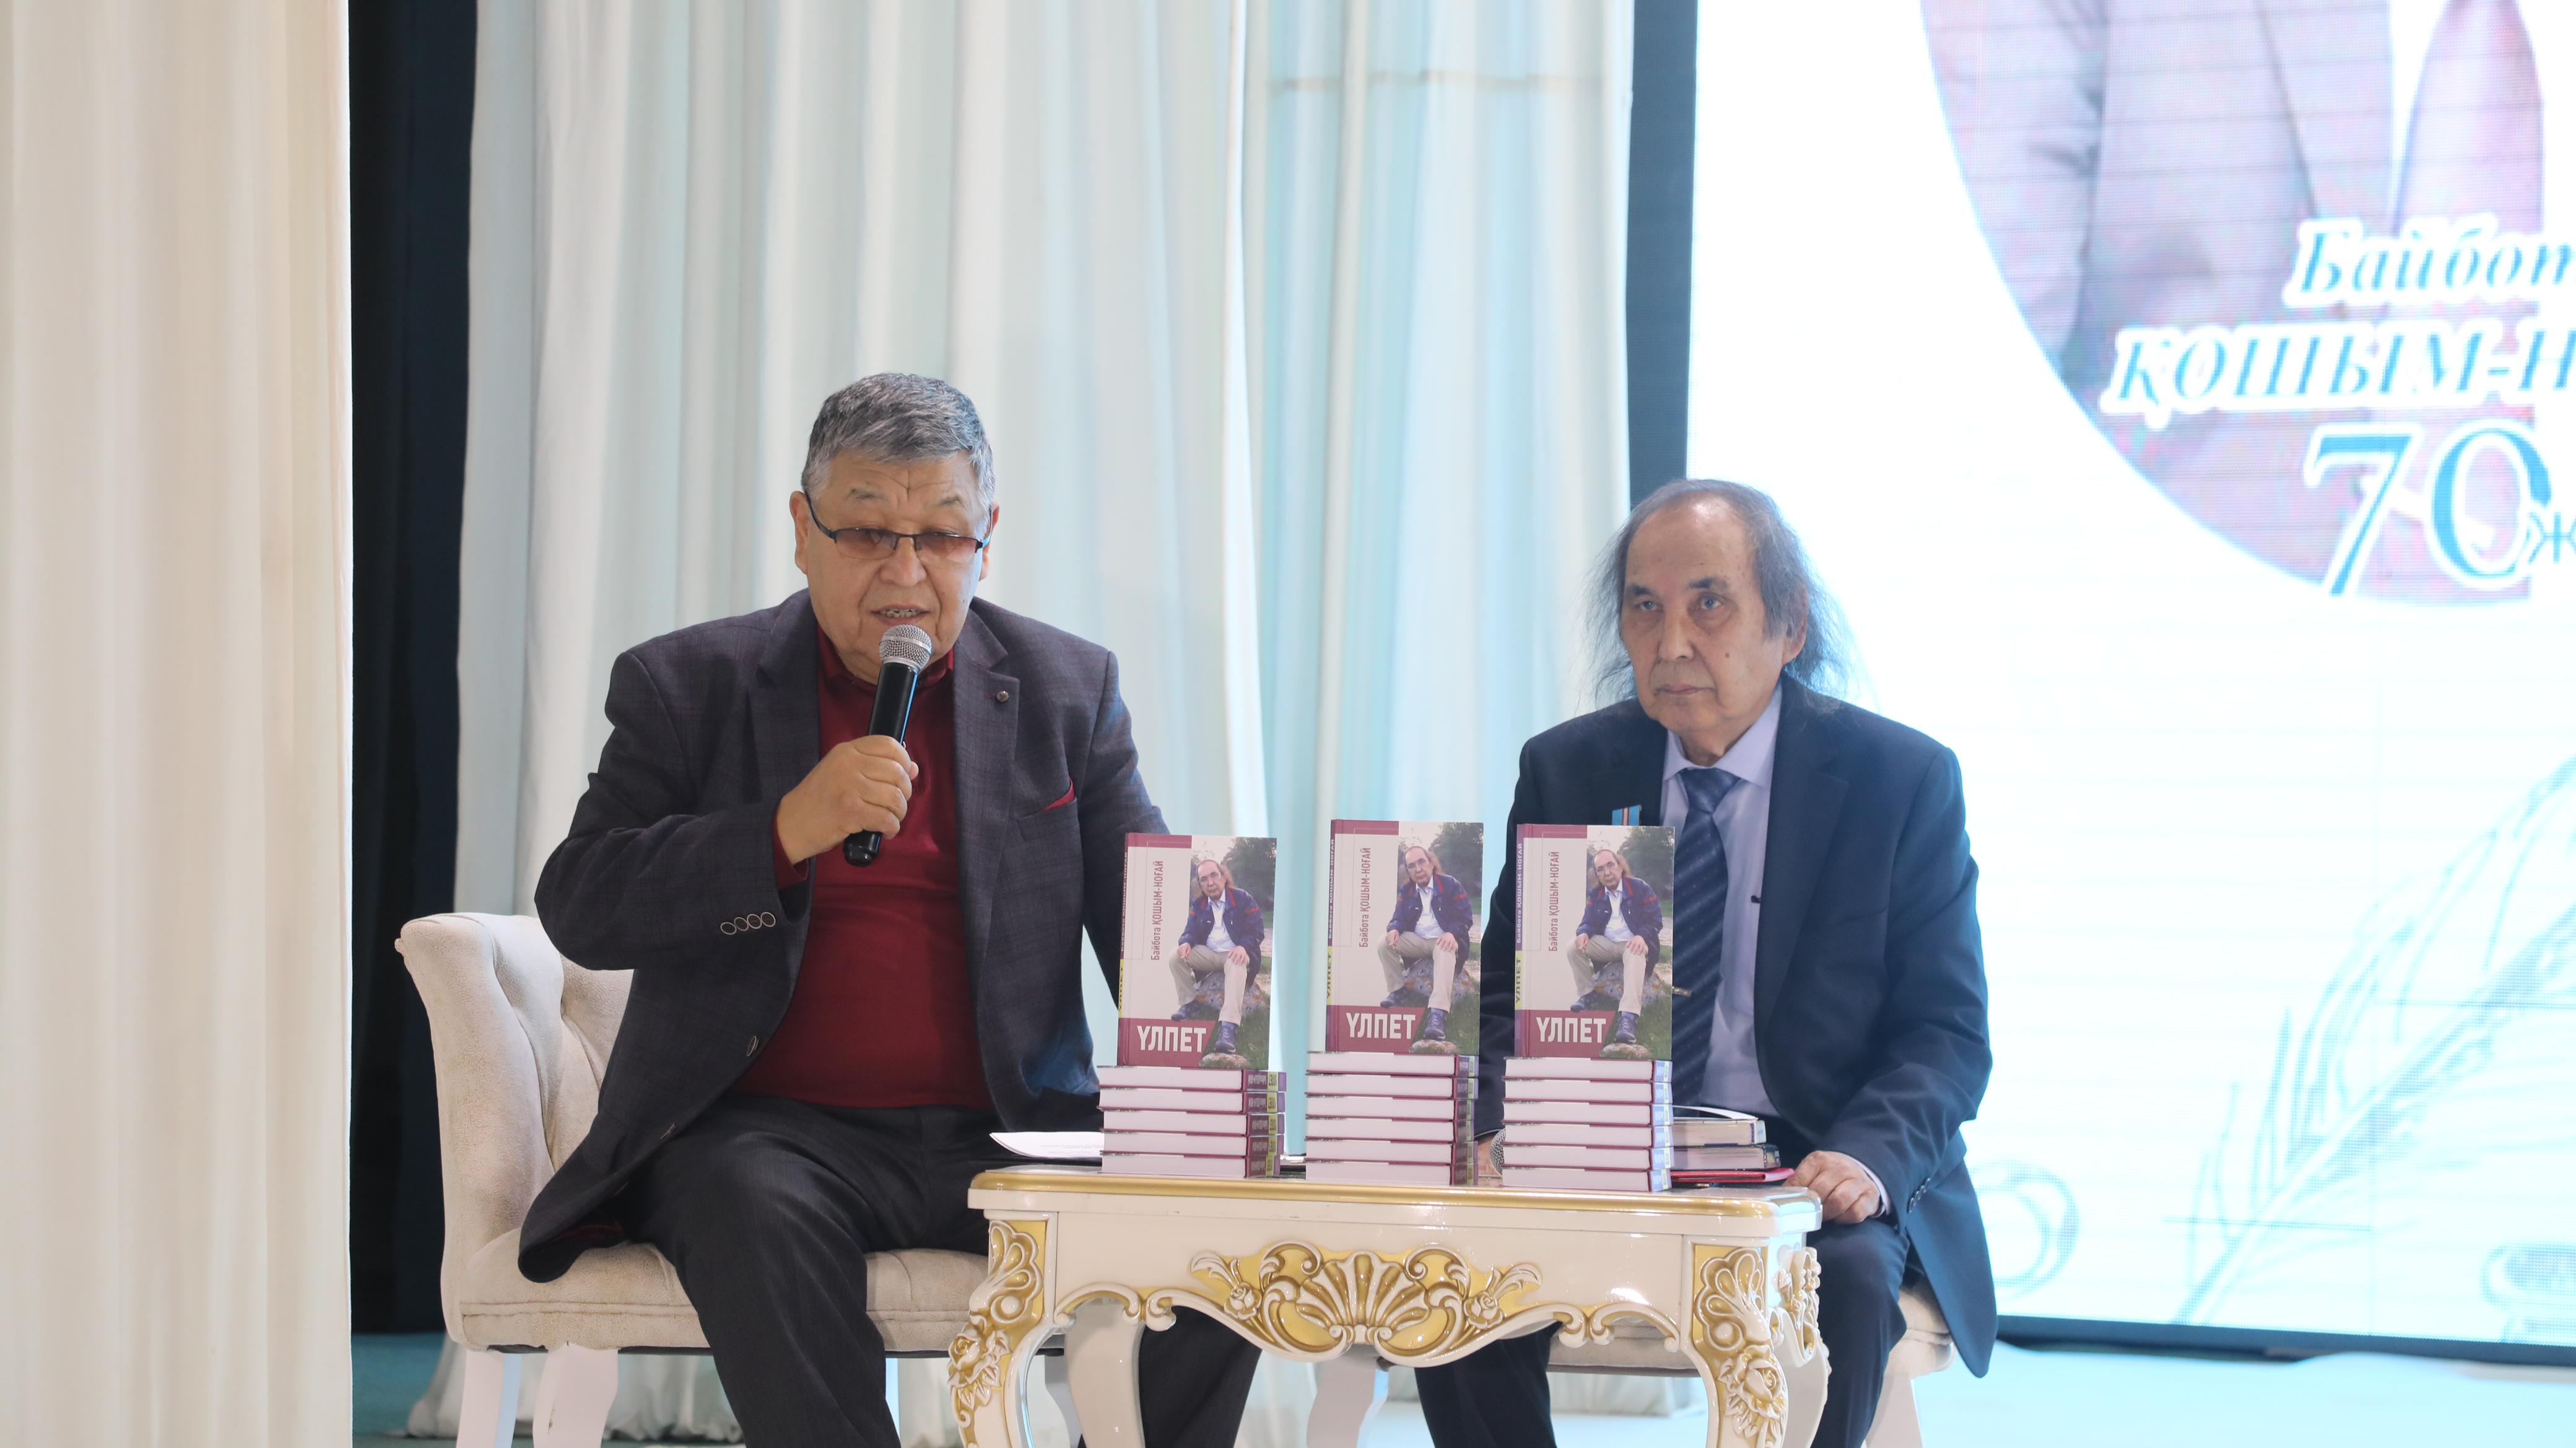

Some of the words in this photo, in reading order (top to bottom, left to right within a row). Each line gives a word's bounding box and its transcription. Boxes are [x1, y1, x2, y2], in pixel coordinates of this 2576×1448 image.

[2310, 425, 2553, 597] 70
[1152, 860, 1164, 925] ҚОШЫМ-НОҒАЙ
[1360, 847, 1371, 912] ҚОШЫМ-НОҒАЙ
[1549, 851, 1560, 916] ҚОШЫМ-НОҒАЙ
[1151, 927, 1161, 961] Байбота
[1359, 914, 1369, 948] Байбота
[1548, 918, 1559, 951] Байбота
[1137, 1024, 1207, 1052] ҮЛПЕТ
[1346, 1012, 1416, 1039] ҮЛПЕТ
[1536, 1016, 1606, 1044] ҮЛПЕТ
